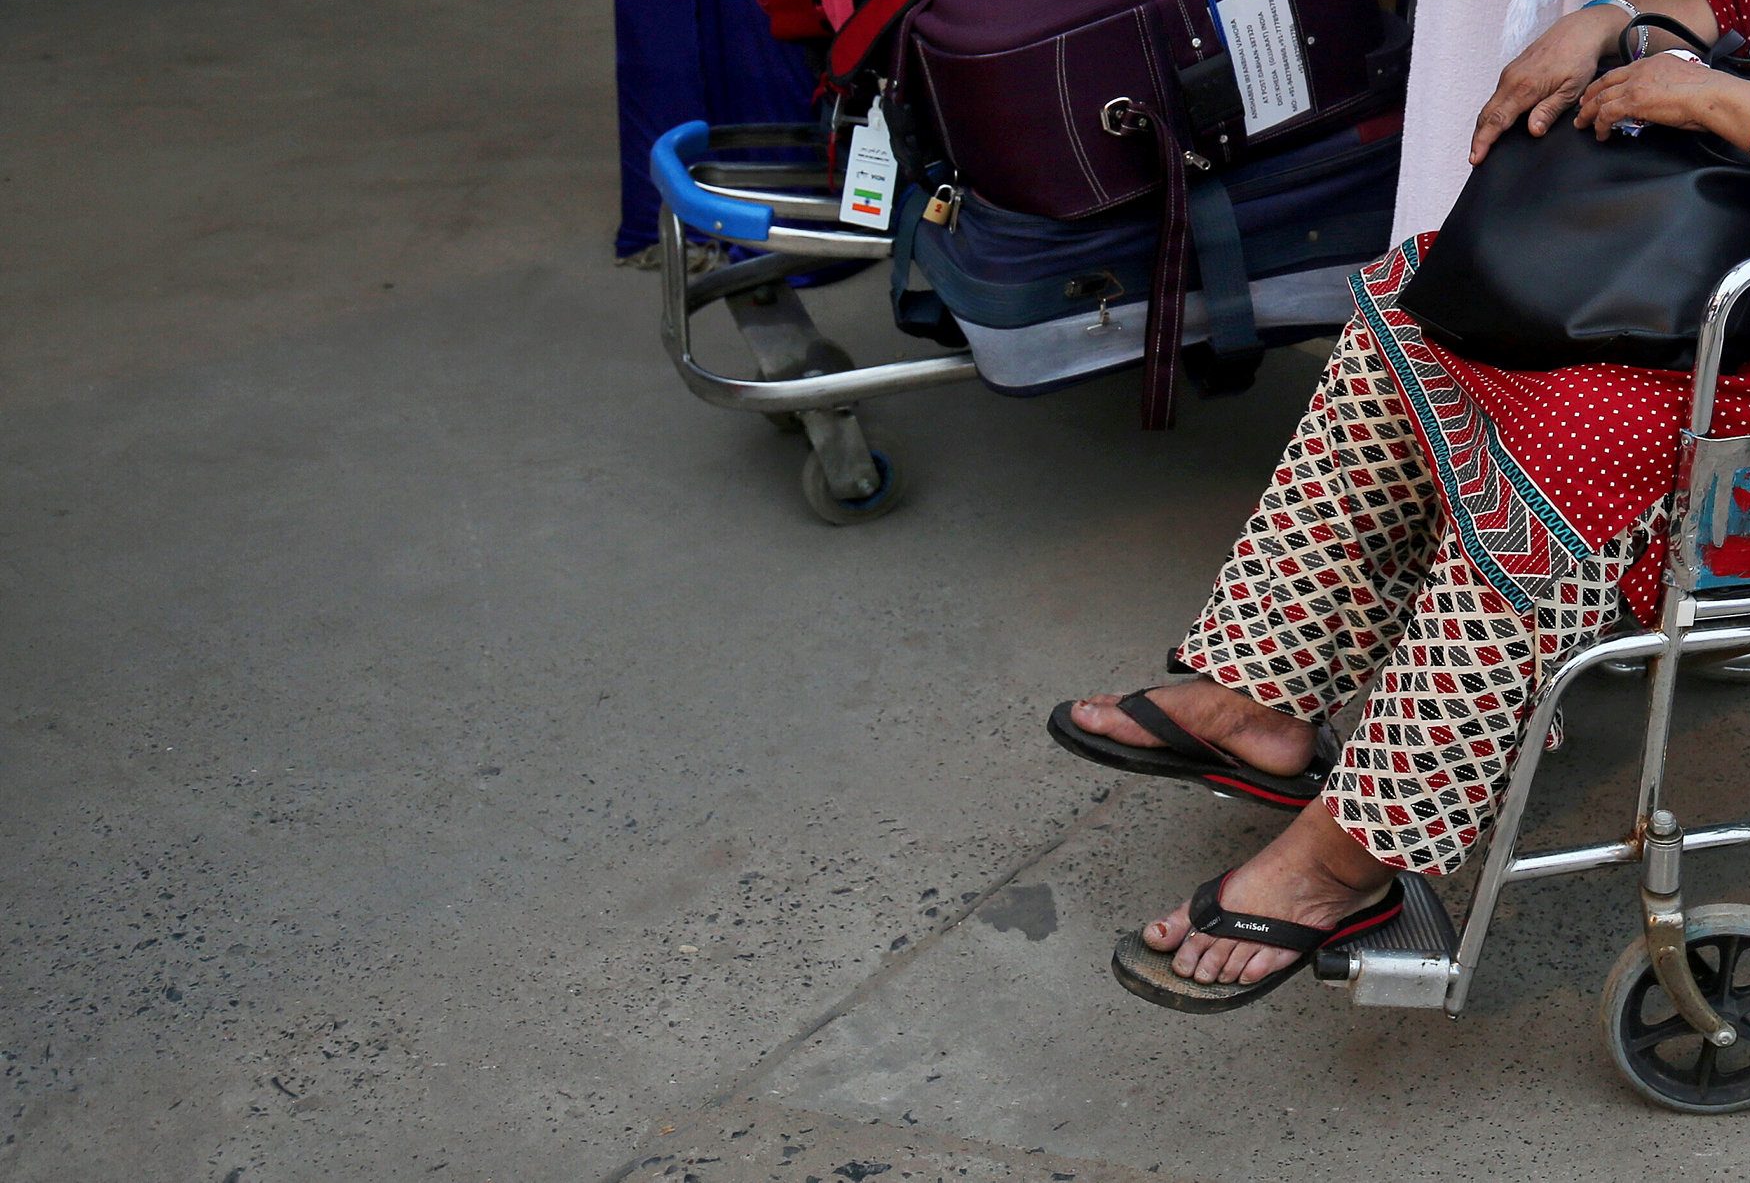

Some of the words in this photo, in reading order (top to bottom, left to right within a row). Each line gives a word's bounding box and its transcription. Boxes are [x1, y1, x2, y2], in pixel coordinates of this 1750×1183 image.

[1230, 18, 1242, 47] VAHORA
[1258, 11, 1267, 30] INDIA
[1262, 30, 1276, 66] (GUJARAT)
[1263, 96, 1269, 104] AT
